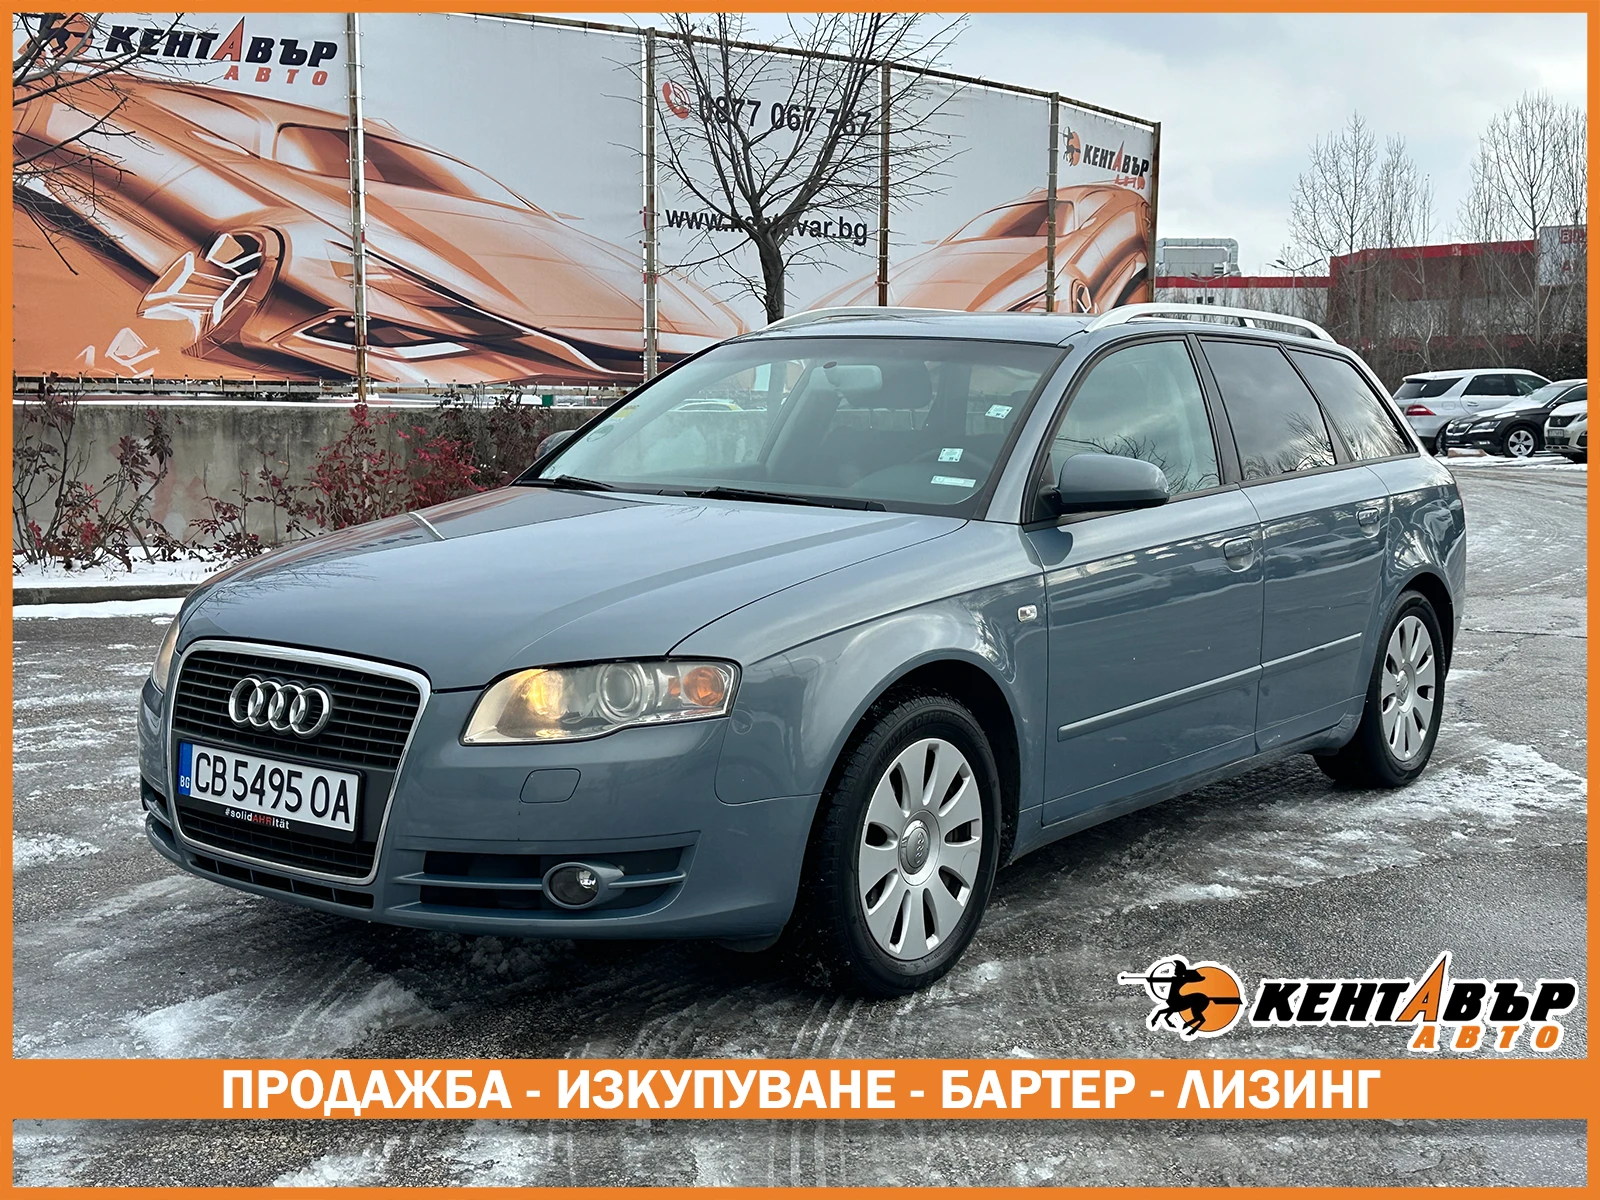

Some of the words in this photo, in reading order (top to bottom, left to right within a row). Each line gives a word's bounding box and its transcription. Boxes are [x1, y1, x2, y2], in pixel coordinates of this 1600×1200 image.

[104, 17, 338, 68] КЕНТАВЪР
[223, 65, 329, 86] АВТО
[770, 102, 817, 133] 067
[1083, 140, 1150, 177] КЕНТАВЪР
[180, 775, 191, 789] BG
[232, 759, 303, 813] 5495
[224, 807, 290, 830] #solidAHRität
